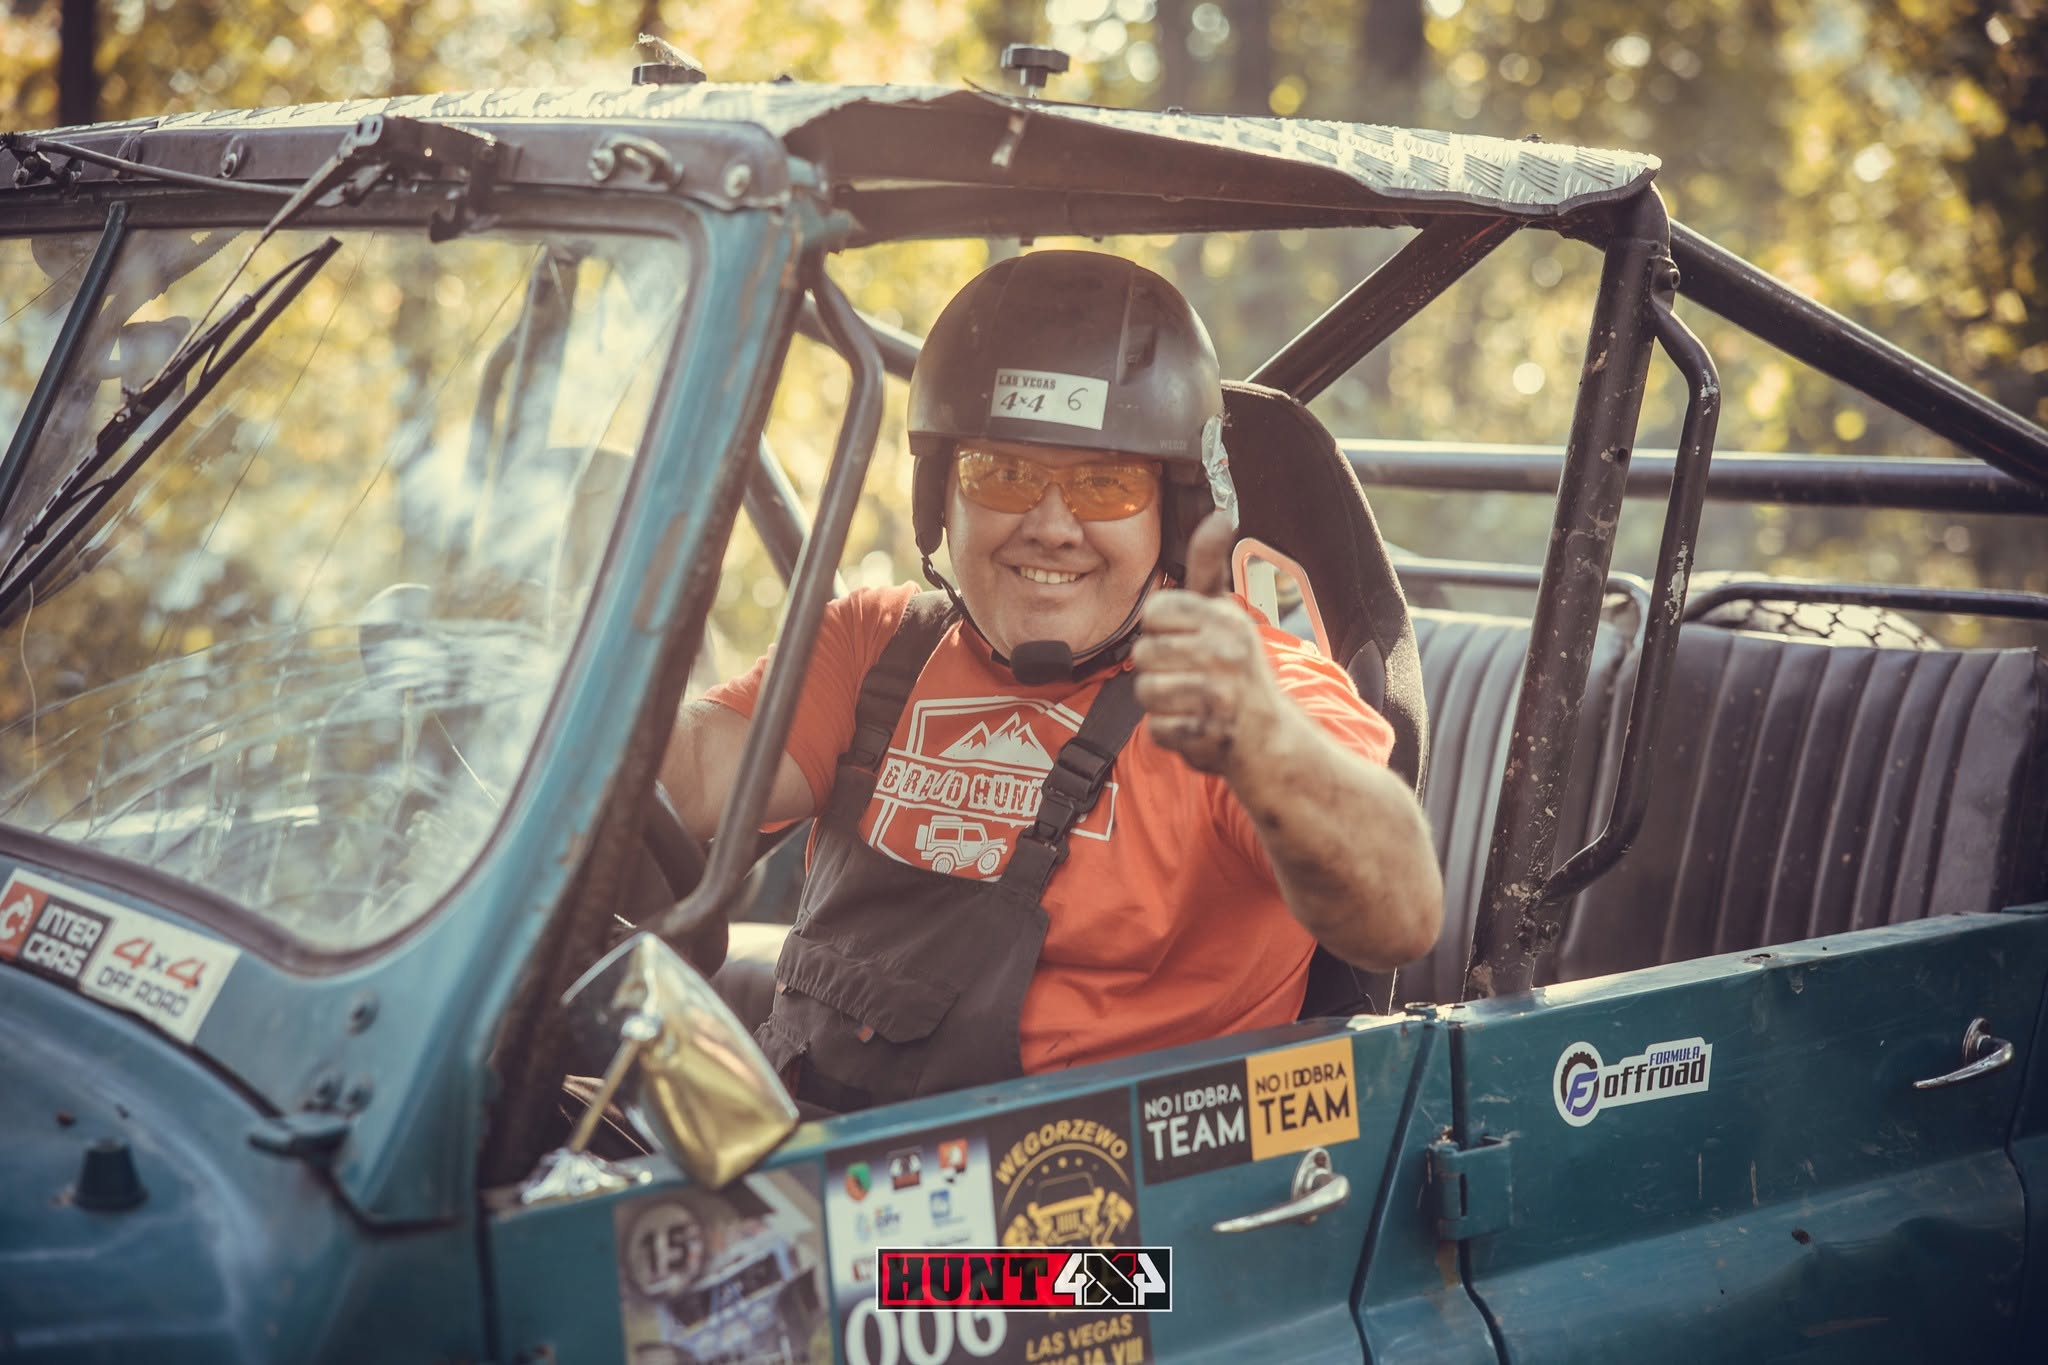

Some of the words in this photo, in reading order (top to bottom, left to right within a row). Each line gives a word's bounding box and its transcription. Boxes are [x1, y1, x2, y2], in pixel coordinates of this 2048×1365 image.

[998, 375, 1018, 387] LAS
[1023, 376, 1056, 389] VEGAS
[1068, 387, 1088, 411] 6
[971, 776, 1044, 813] HUNT
[38, 904, 103, 950] INTER
[22, 932, 89, 977] CARS
[113, 938, 206, 989] 4x4
[97, 966, 135, 993] OFF
[133, 975, 190, 1017] ROAD
[1255, 1074, 1281, 1096] NO
[1604, 1054, 1706, 1098] offroad
[1145, 1096, 1173, 1121] NO
[1259, 1085, 1350, 1135] TEAM
[1147, 1106, 1245, 1160] TEAM
[1026, 1331, 1065, 1361] LAS
[1068, 1313, 1133, 1349] VEGAS
